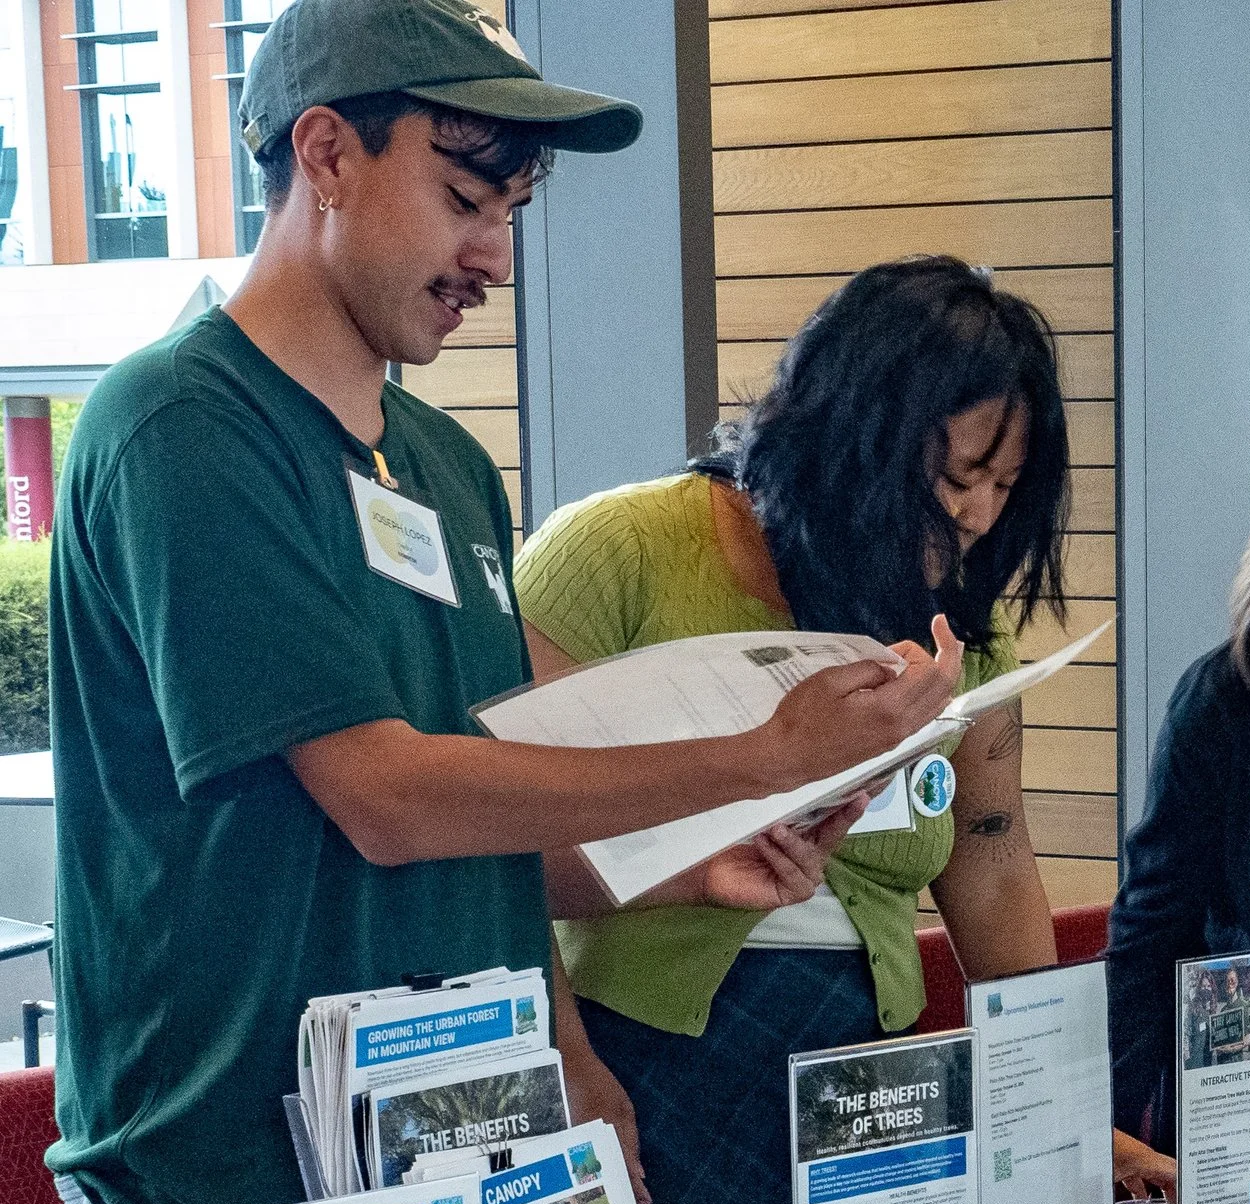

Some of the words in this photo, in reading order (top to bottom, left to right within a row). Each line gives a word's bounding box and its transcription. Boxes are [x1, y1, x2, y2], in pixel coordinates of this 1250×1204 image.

[9, 476, 32, 541] nford
[404, 526, 432, 547] LOPEZ
[368, 1024, 413, 1044] GROWING
[415, 1021, 433, 1034] THE
[435, 1015, 466, 1032] URBAN
[467, 1007, 500, 1026] FOREST
[368, 1048, 378, 1059] IN
[380, 1037, 431, 1057] MOUNTAIN
[433, 1032, 456, 1046] VIEW
[1200, 1072, 1242, 1087] INTERACTIVE
[836, 1092, 867, 1115] THE
[870, 1081, 939, 1110] BENEFITS
[420, 1130, 453, 1154] THE
[456, 1113, 530, 1148] BENEFITS
[853, 1115, 872, 1135] OF
[875, 1107, 923, 1131] TREES
